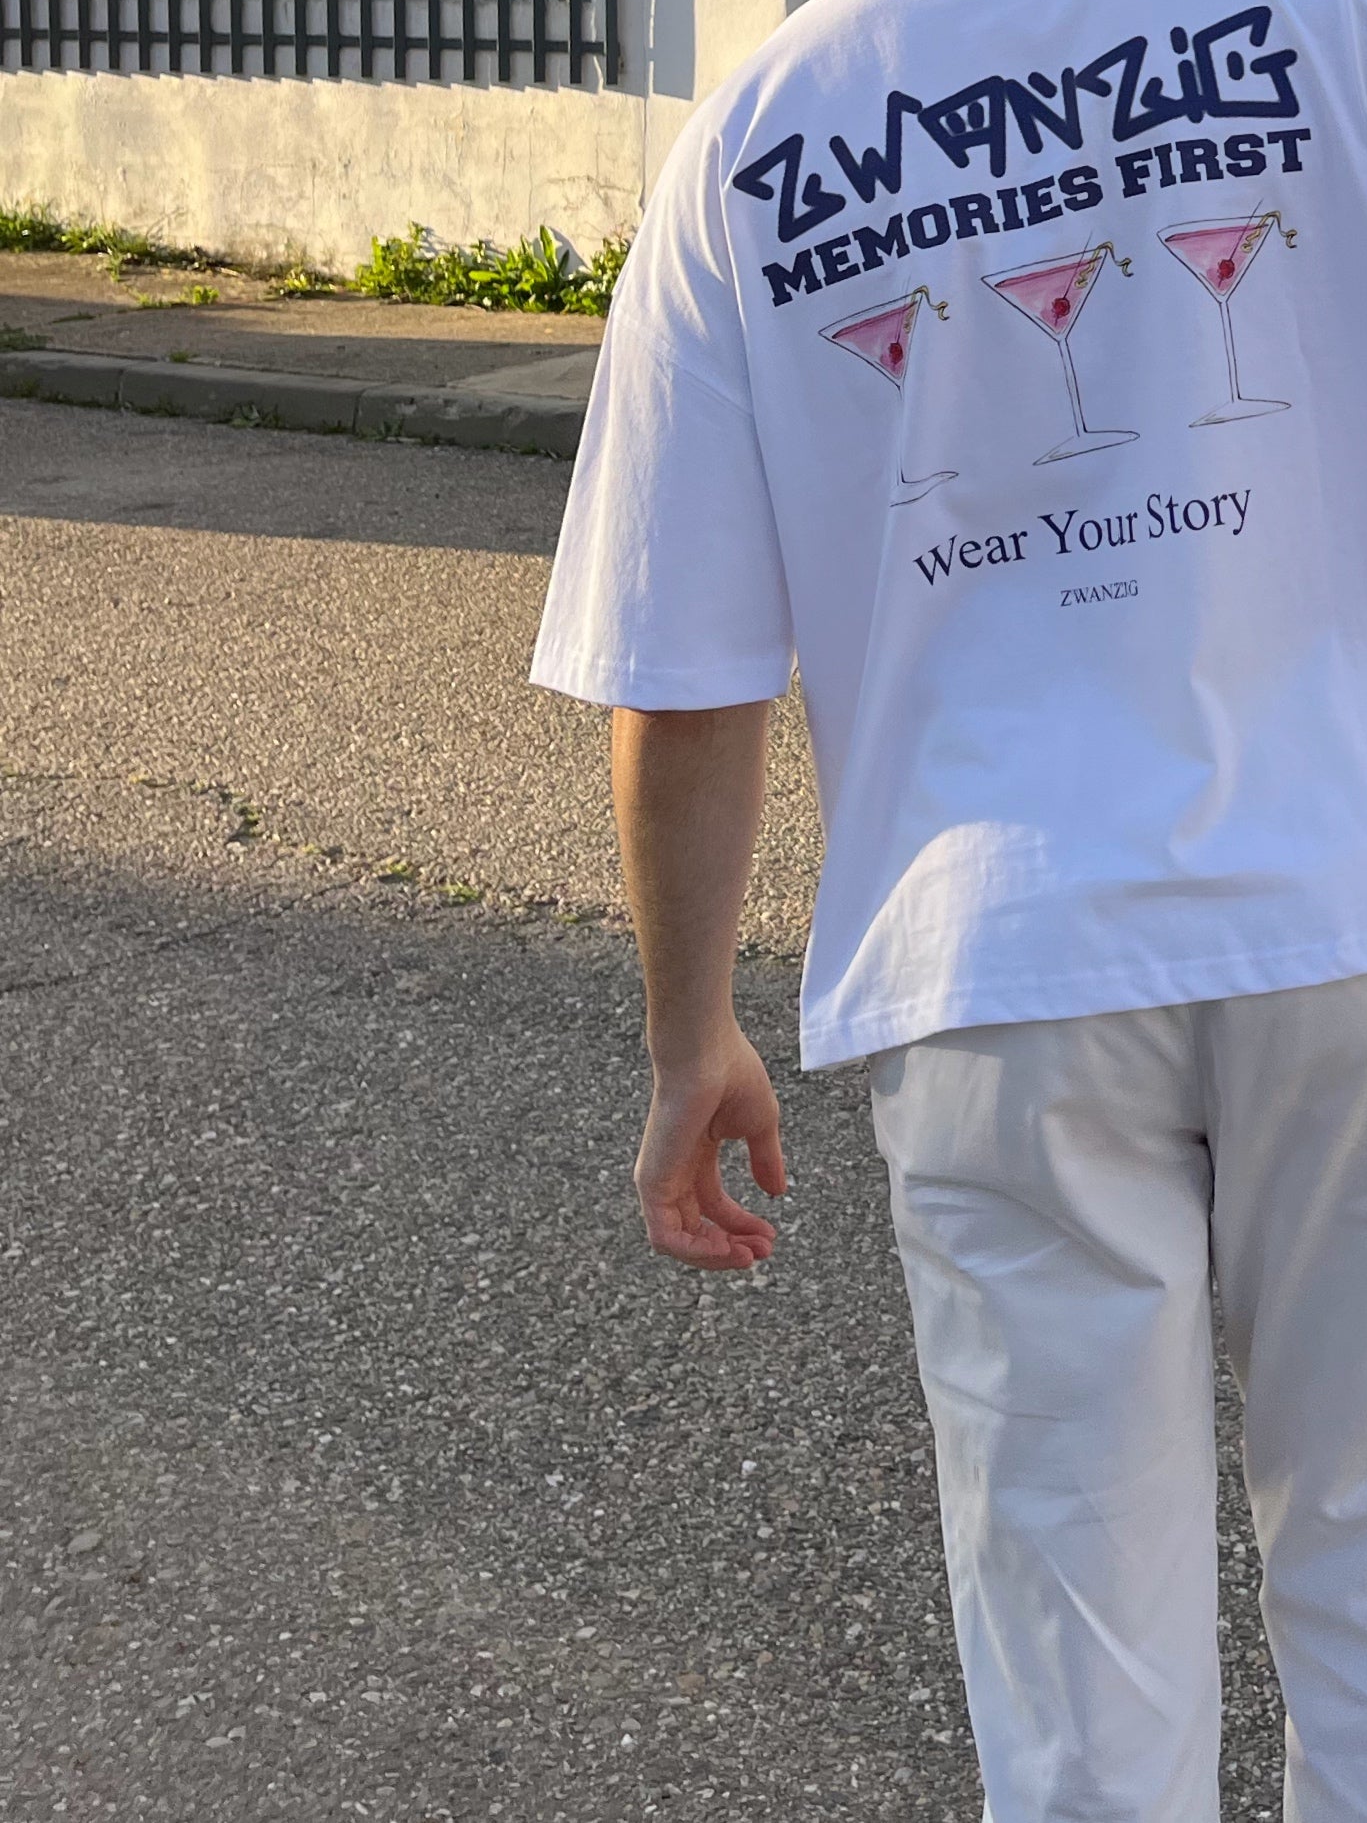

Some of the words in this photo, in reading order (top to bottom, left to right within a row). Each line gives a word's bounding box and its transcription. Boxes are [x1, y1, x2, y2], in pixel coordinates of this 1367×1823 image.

[761, 164, 1104, 308] MEMORIES
[1114, 127, 1312, 199] FIRST
[912, 531, 1029, 587] Wear
[1036, 509, 1138, 555] Your
[1146, 489, 1251, 539] Story
[1060, 579, 1139, 608] ZWANZIG
